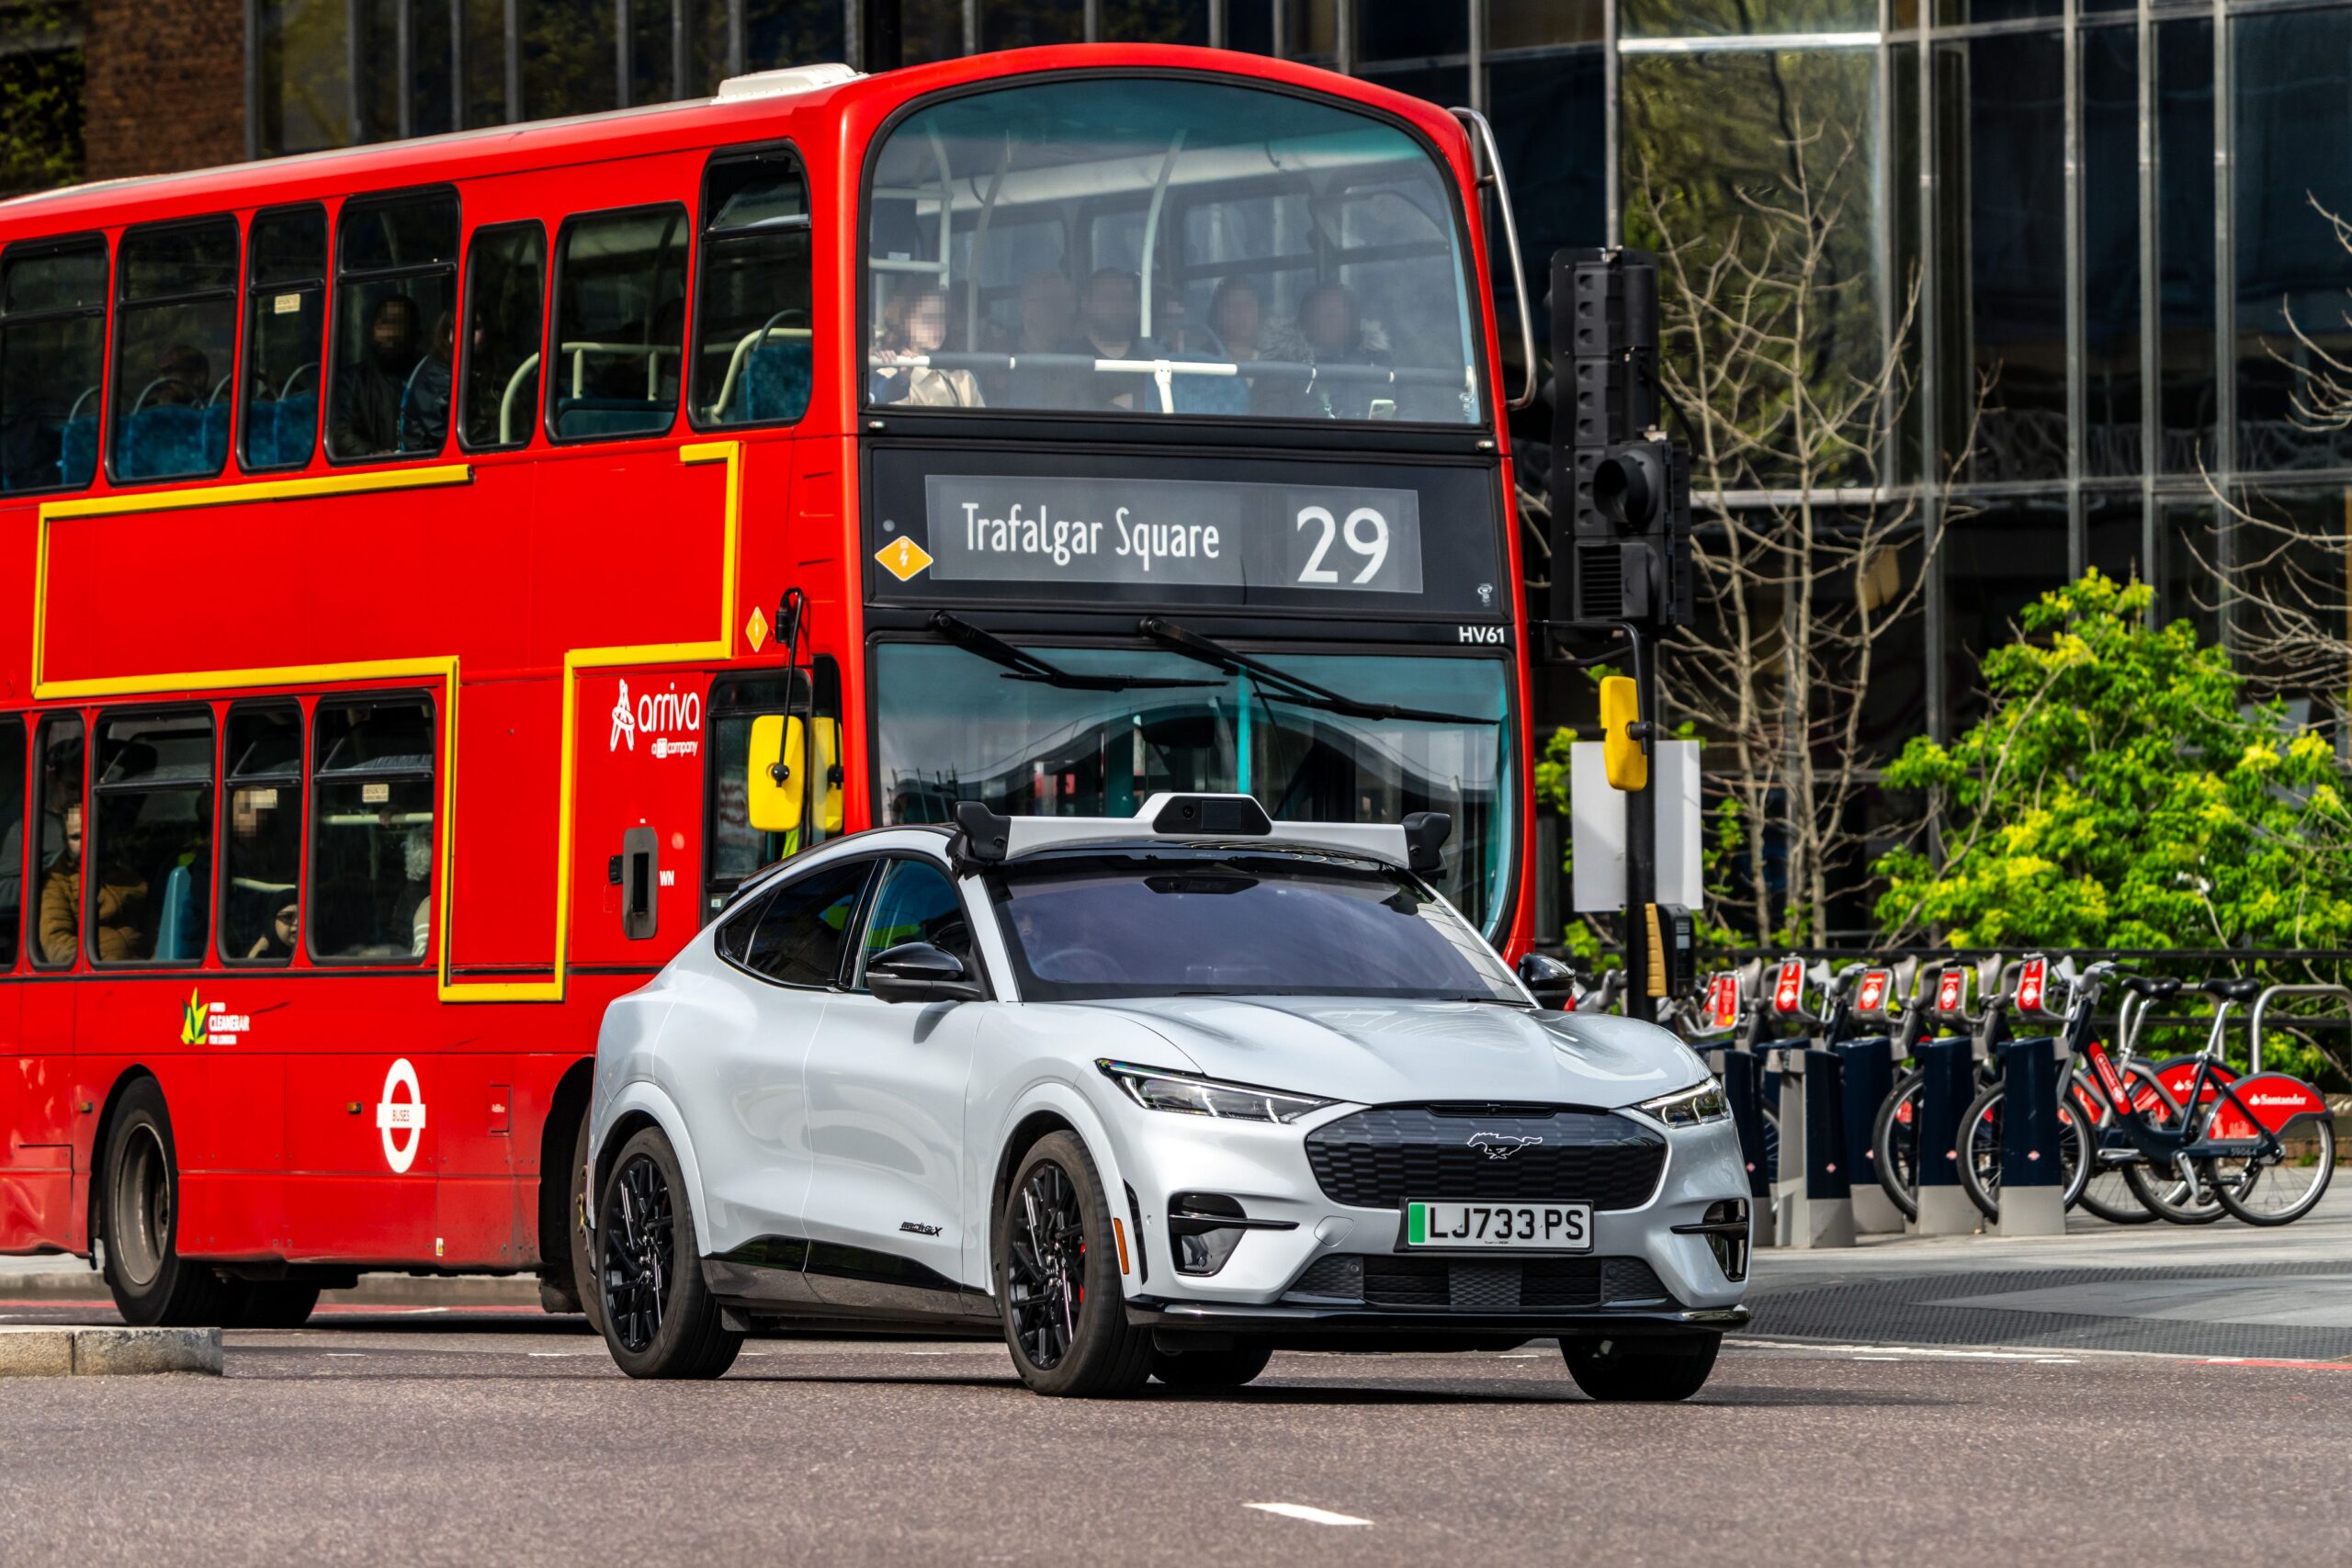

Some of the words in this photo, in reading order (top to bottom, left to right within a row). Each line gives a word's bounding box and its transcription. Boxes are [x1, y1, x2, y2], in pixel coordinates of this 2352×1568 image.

[962, 502, 1102, 566] Trafalgar
[1115, 506, 1220, 571] Square
[1296, 505, 1389, 584] 29
[1458, 626, 1505, 643] HV61
[638, 682, 700, 733] arriva
[667, 740, 699, 758] company
[659, 870, 675, 886] WN
[2259, 1093, 2307, 1105] Santander
